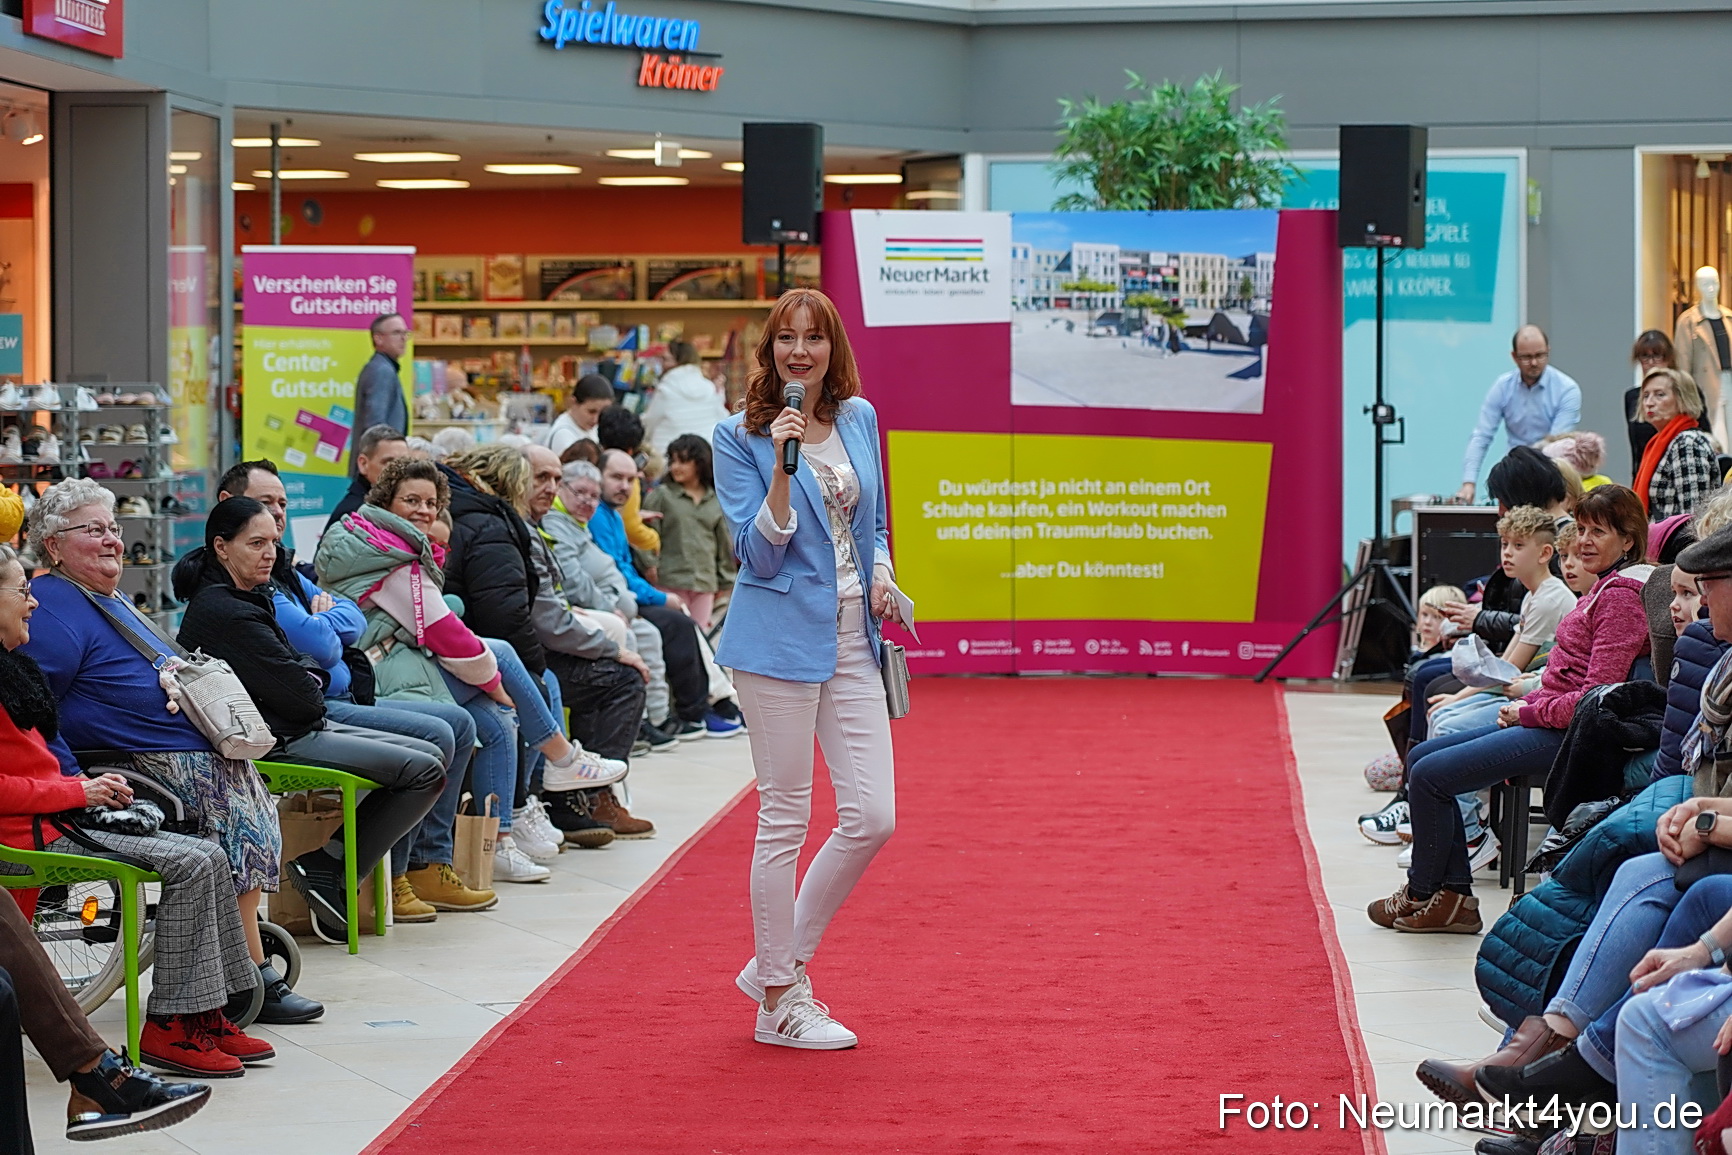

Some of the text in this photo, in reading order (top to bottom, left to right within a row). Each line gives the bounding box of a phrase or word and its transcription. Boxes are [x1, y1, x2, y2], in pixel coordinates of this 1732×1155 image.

[540, 0, 701, 51] Spielwaren
[638, 53, 725, 91] Krömer
[879, 265, 991, 283] NeuerMarkt
[252, 275, 398, 295] Verschenken Sie
[290, 296, 397, 315] Gutscheine!
[0, 336, 18, 350] EW
[262, 352, 338, 373] Center-
[270, 378, 357, 398] Gutsche
[938, 478, 1212, 499] Du würdest ja nicht an einem Ort
[922, 500, 1227, 518] Schuhe kaufen, ein Workout machen
[936, 522, 1214, 540] und deinen Traumurlaub buchen.
[1056, 560, 1081, 578] Du
[1083, 560, 1165, 579] könntest!
[410, 573, 424, 639] LOVE THE UNIQUE
